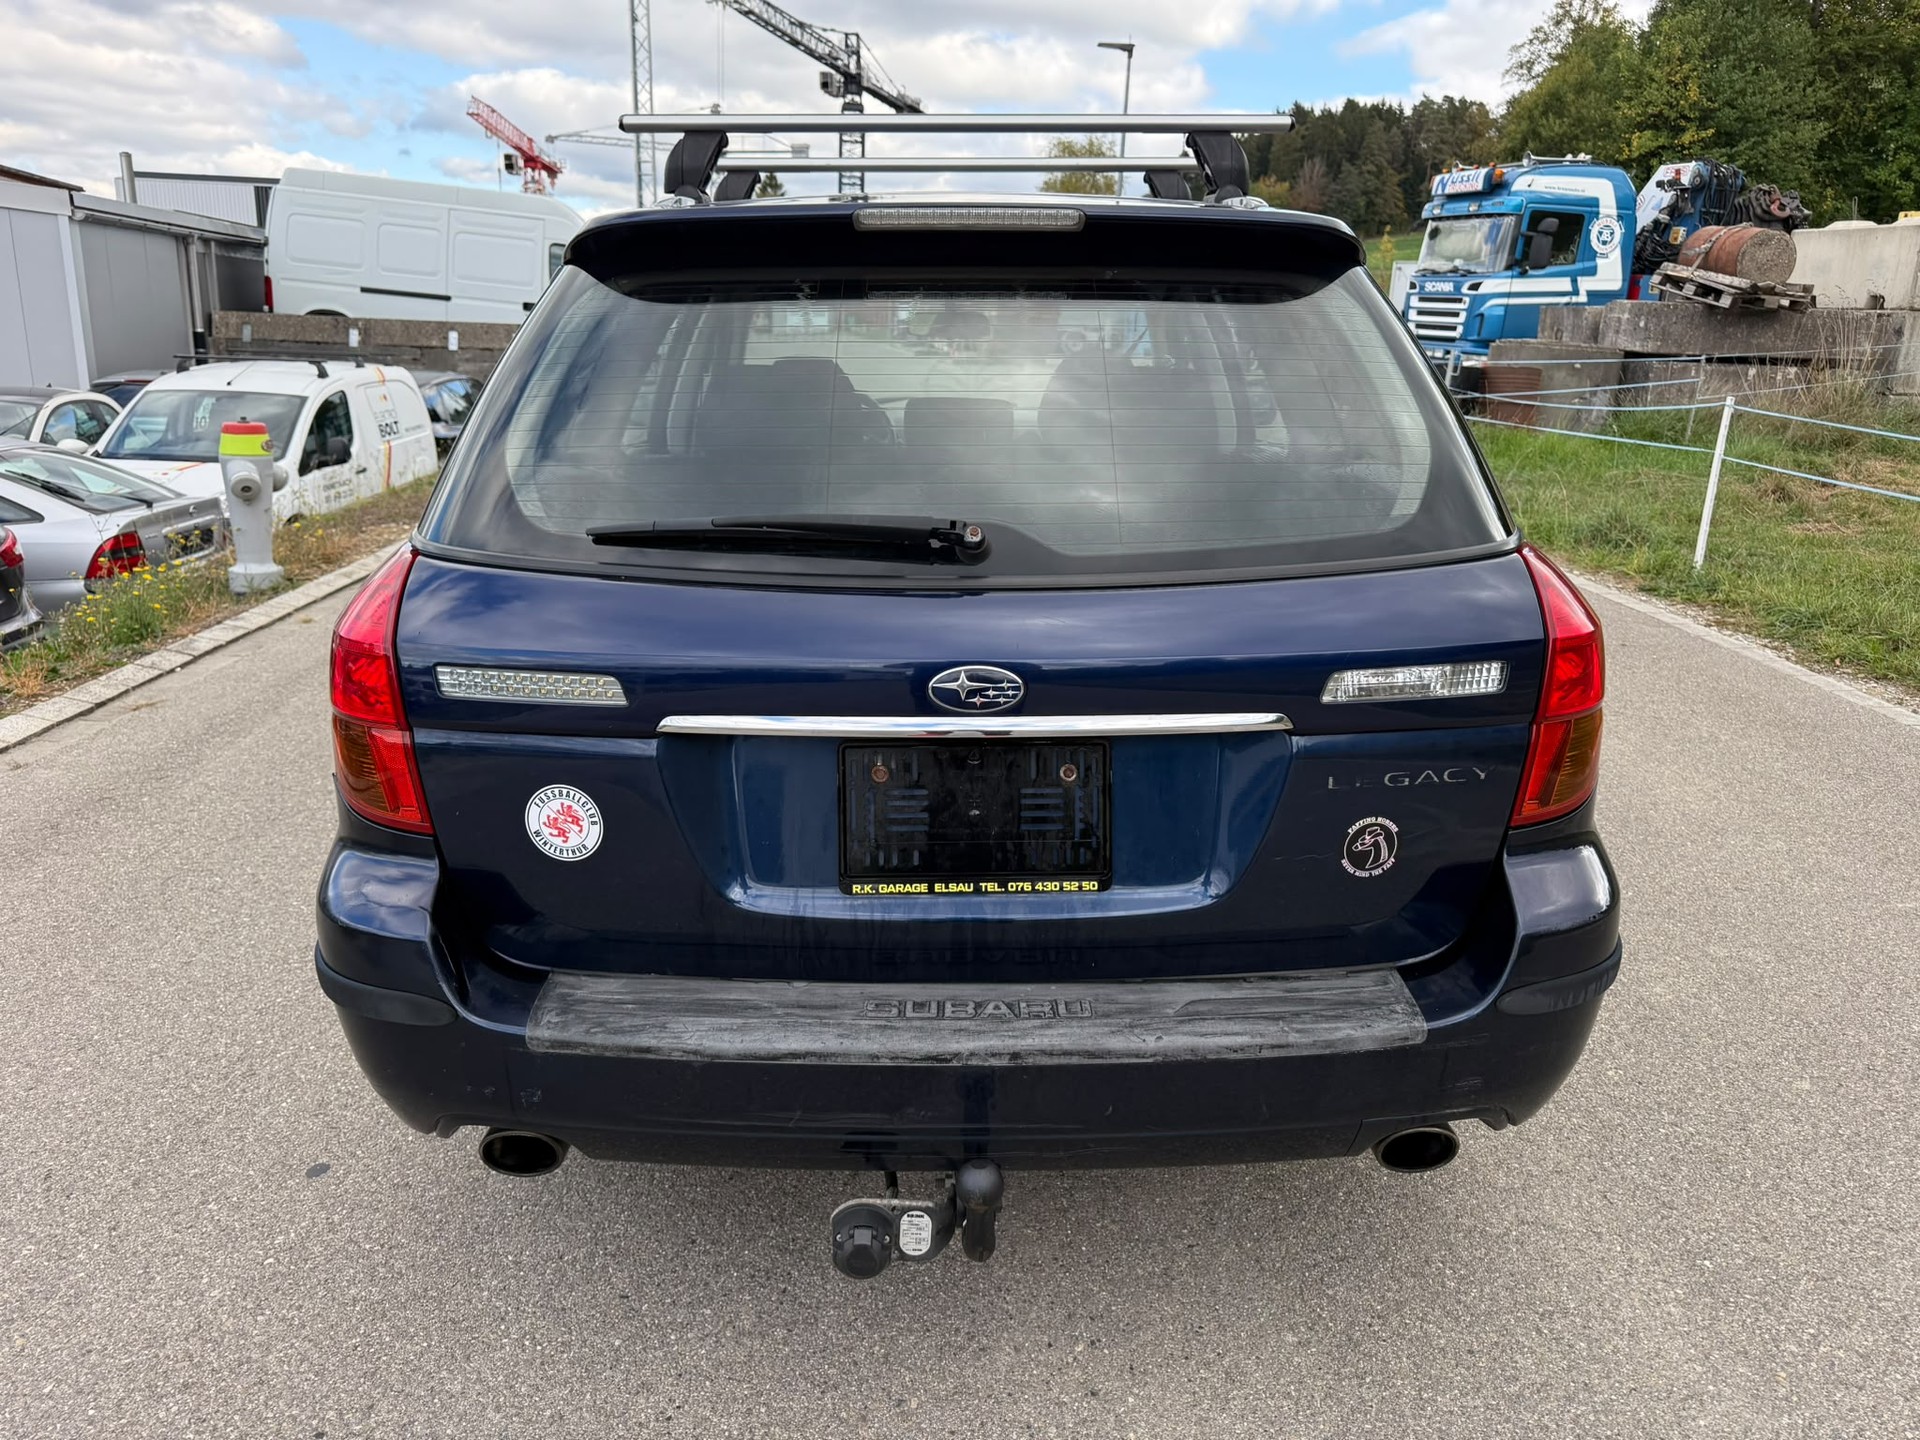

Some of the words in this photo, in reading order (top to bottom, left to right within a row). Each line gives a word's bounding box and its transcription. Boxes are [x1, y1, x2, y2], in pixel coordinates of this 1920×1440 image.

[1424, 281, 1454, 292] SCANIA
[378, 421, 400, 438] BOLT
[534, 789, 598, 826] FUSSBALLCLUB
[533, 829, 590, 857] WINTERTHUR
[852, 884, 876, 894] R.K.
[878, 883, 929, 893] GARAGE
[934, 882, 974, 893] ELSAU
[979, 882, 1005, 892] TEL.
[1007, 882, 1032, 892] 076
[1034, 881, 1060, 891] 430
[1062, 881, 1079, 891] 52
[1081, 881, 1099, 890] 50
[864, 998, 1093, 1020] SUBARU
